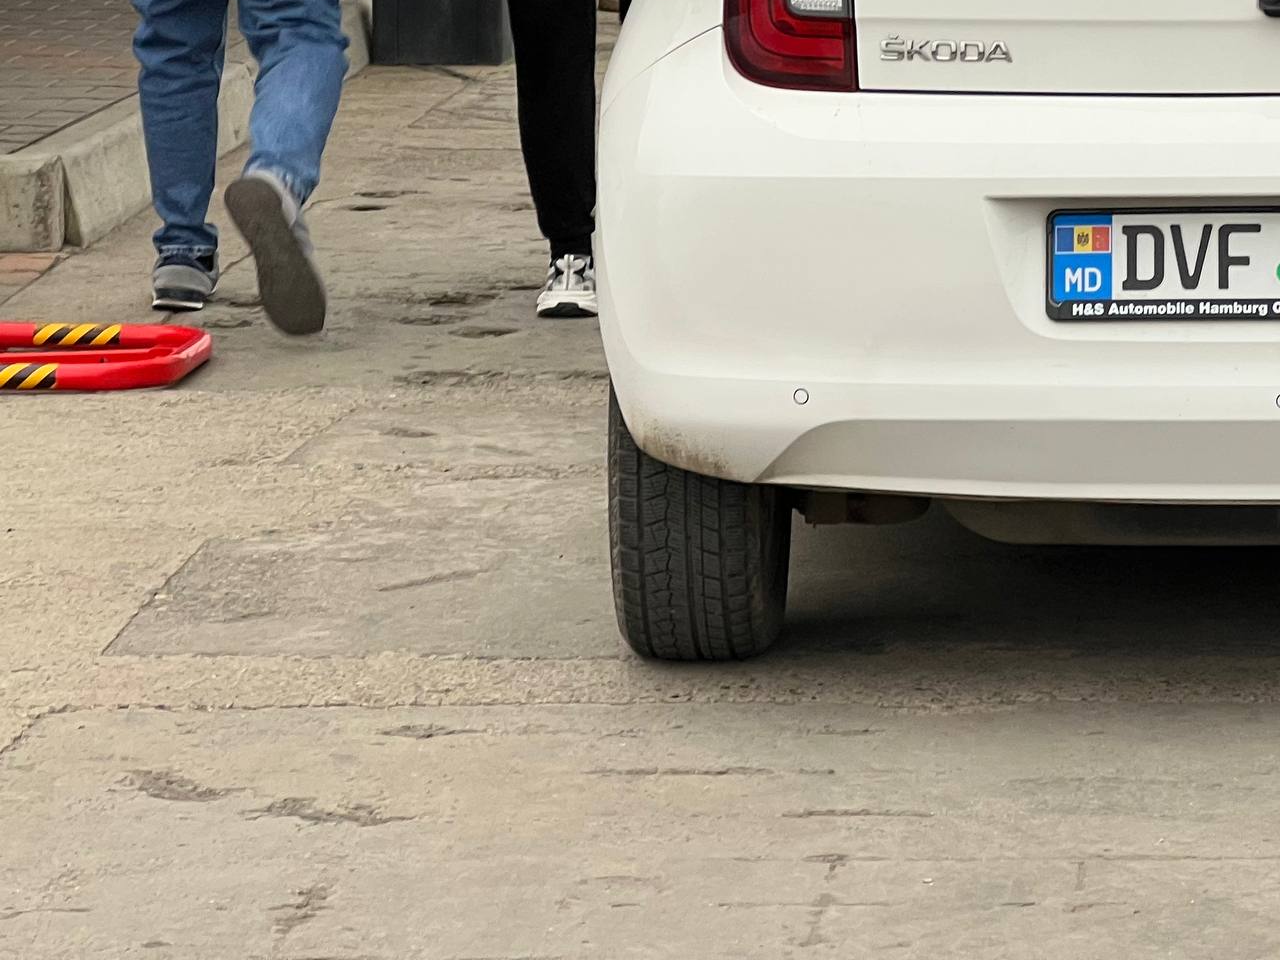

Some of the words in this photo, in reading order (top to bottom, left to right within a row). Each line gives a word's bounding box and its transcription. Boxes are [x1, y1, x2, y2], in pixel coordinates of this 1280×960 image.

[880, 34, 1014, 63] ŠKODA
[1121, 223, 1263, 291] DVF
[1064, 267, 1103, 294] MD
[1072, 303, 1105, 316] H&S
[1108, 302, 1195, 315] Automobile
[1199, 301, 1269, 317] Hamburg
